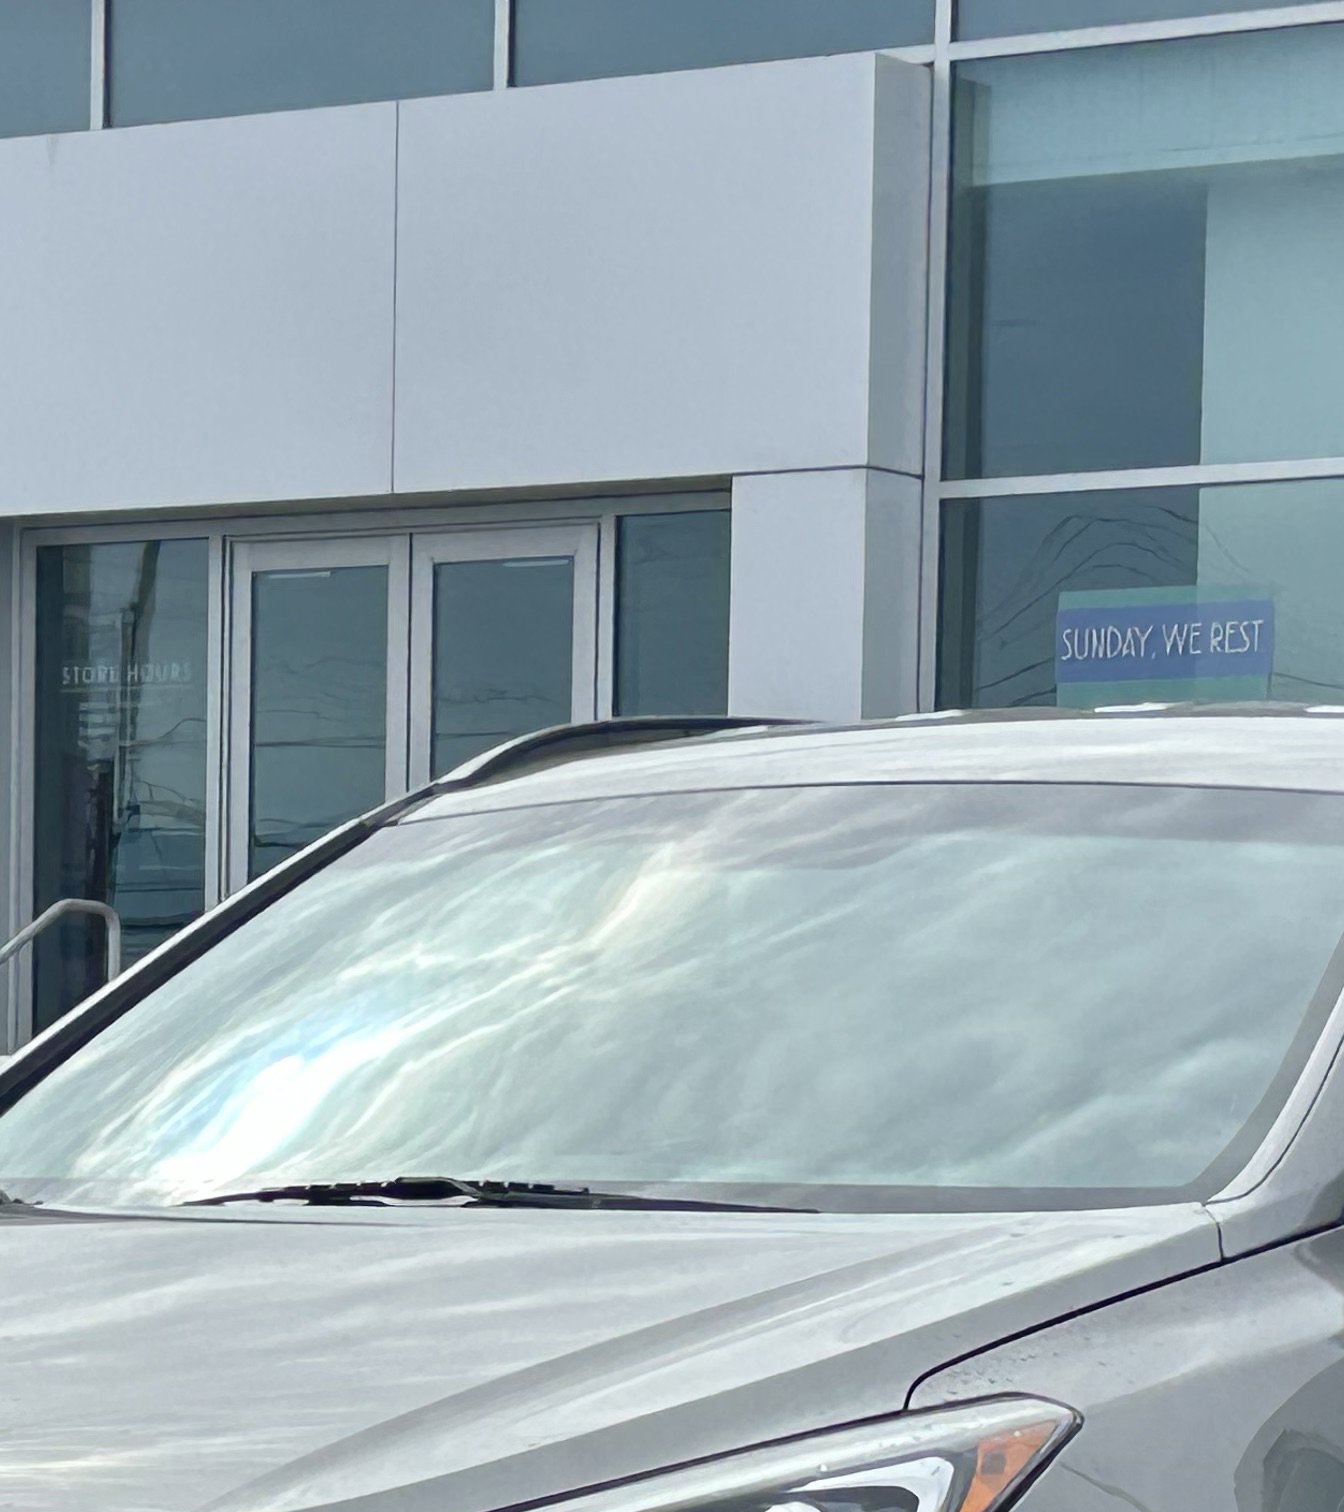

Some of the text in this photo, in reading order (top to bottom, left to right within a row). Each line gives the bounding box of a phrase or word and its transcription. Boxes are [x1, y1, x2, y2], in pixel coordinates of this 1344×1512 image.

[1162, 622, 1203, 656] WE
[1210, 619, 1265, 654] REST
[61, 661, 194, 686] STORE HOURS
